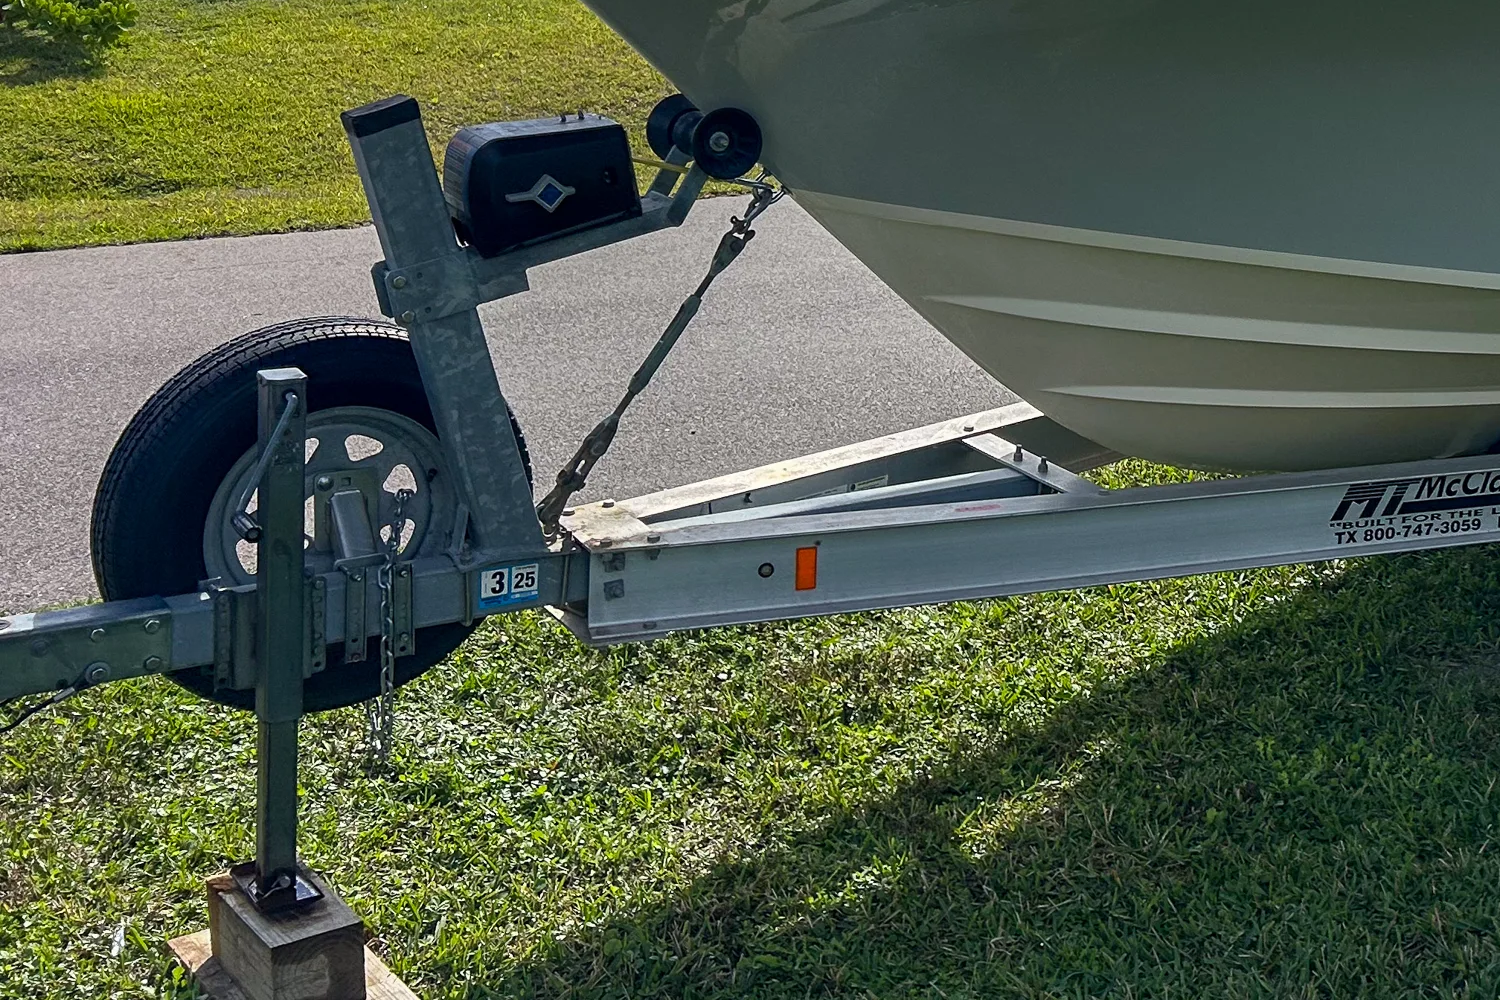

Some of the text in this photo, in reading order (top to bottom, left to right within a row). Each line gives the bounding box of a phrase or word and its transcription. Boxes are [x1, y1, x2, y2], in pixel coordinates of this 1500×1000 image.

[1401, 512, 1442, 524] FOR
[1449, 507, 1484, 519] THE
[1334, 517, 1482, 545] TX 800-747-3059
[490, 570, 505, 595] 3
[513, 571, 536, 590] 25
